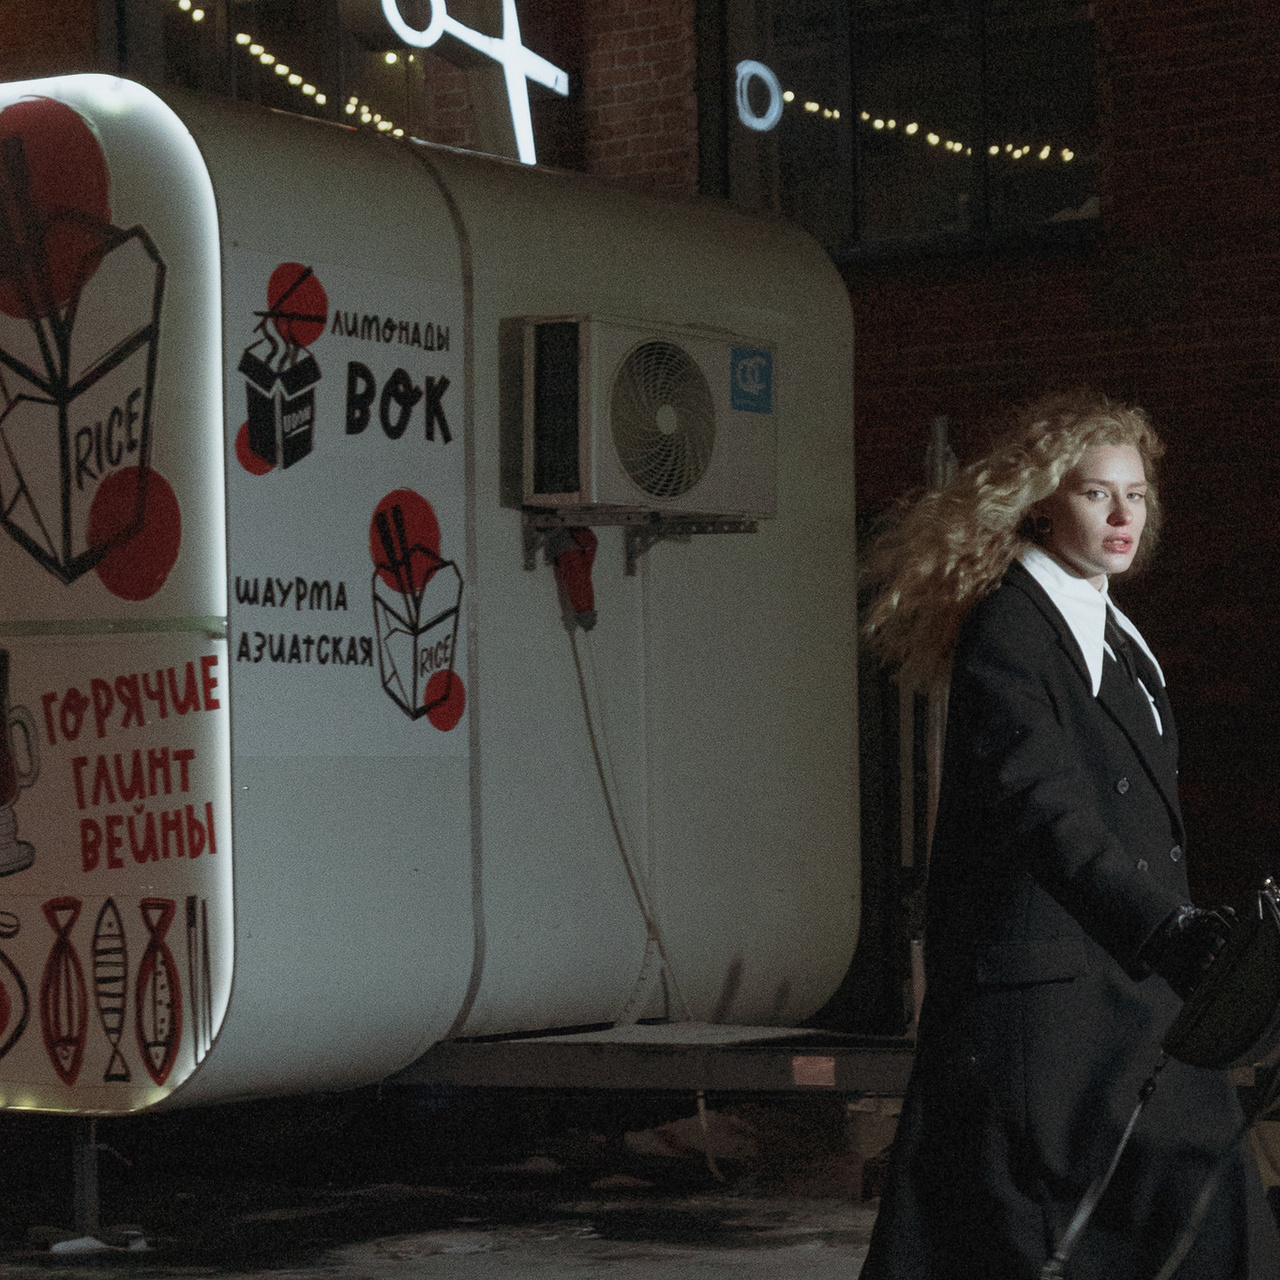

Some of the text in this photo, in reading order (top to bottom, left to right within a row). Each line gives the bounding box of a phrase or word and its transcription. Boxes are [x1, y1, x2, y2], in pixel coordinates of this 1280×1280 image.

[331, 310, 450, 351] ЛИМОНАДЫ
[346, 361, 452, 444] ВОК
[74, 387, 142, 491] RICE
[235, 576, 348, 611] ШАУРМА
[236, 631, 374, 666] АЗИАТСКАЯ
[420, 634, 452, 677] RICE
[41, 655, 220, 746] ГОРЯЧИЕ
[72, 746, 195, 810] ГЛИНТ
[79, 802, 217, 872] ВЕЙНЫ
